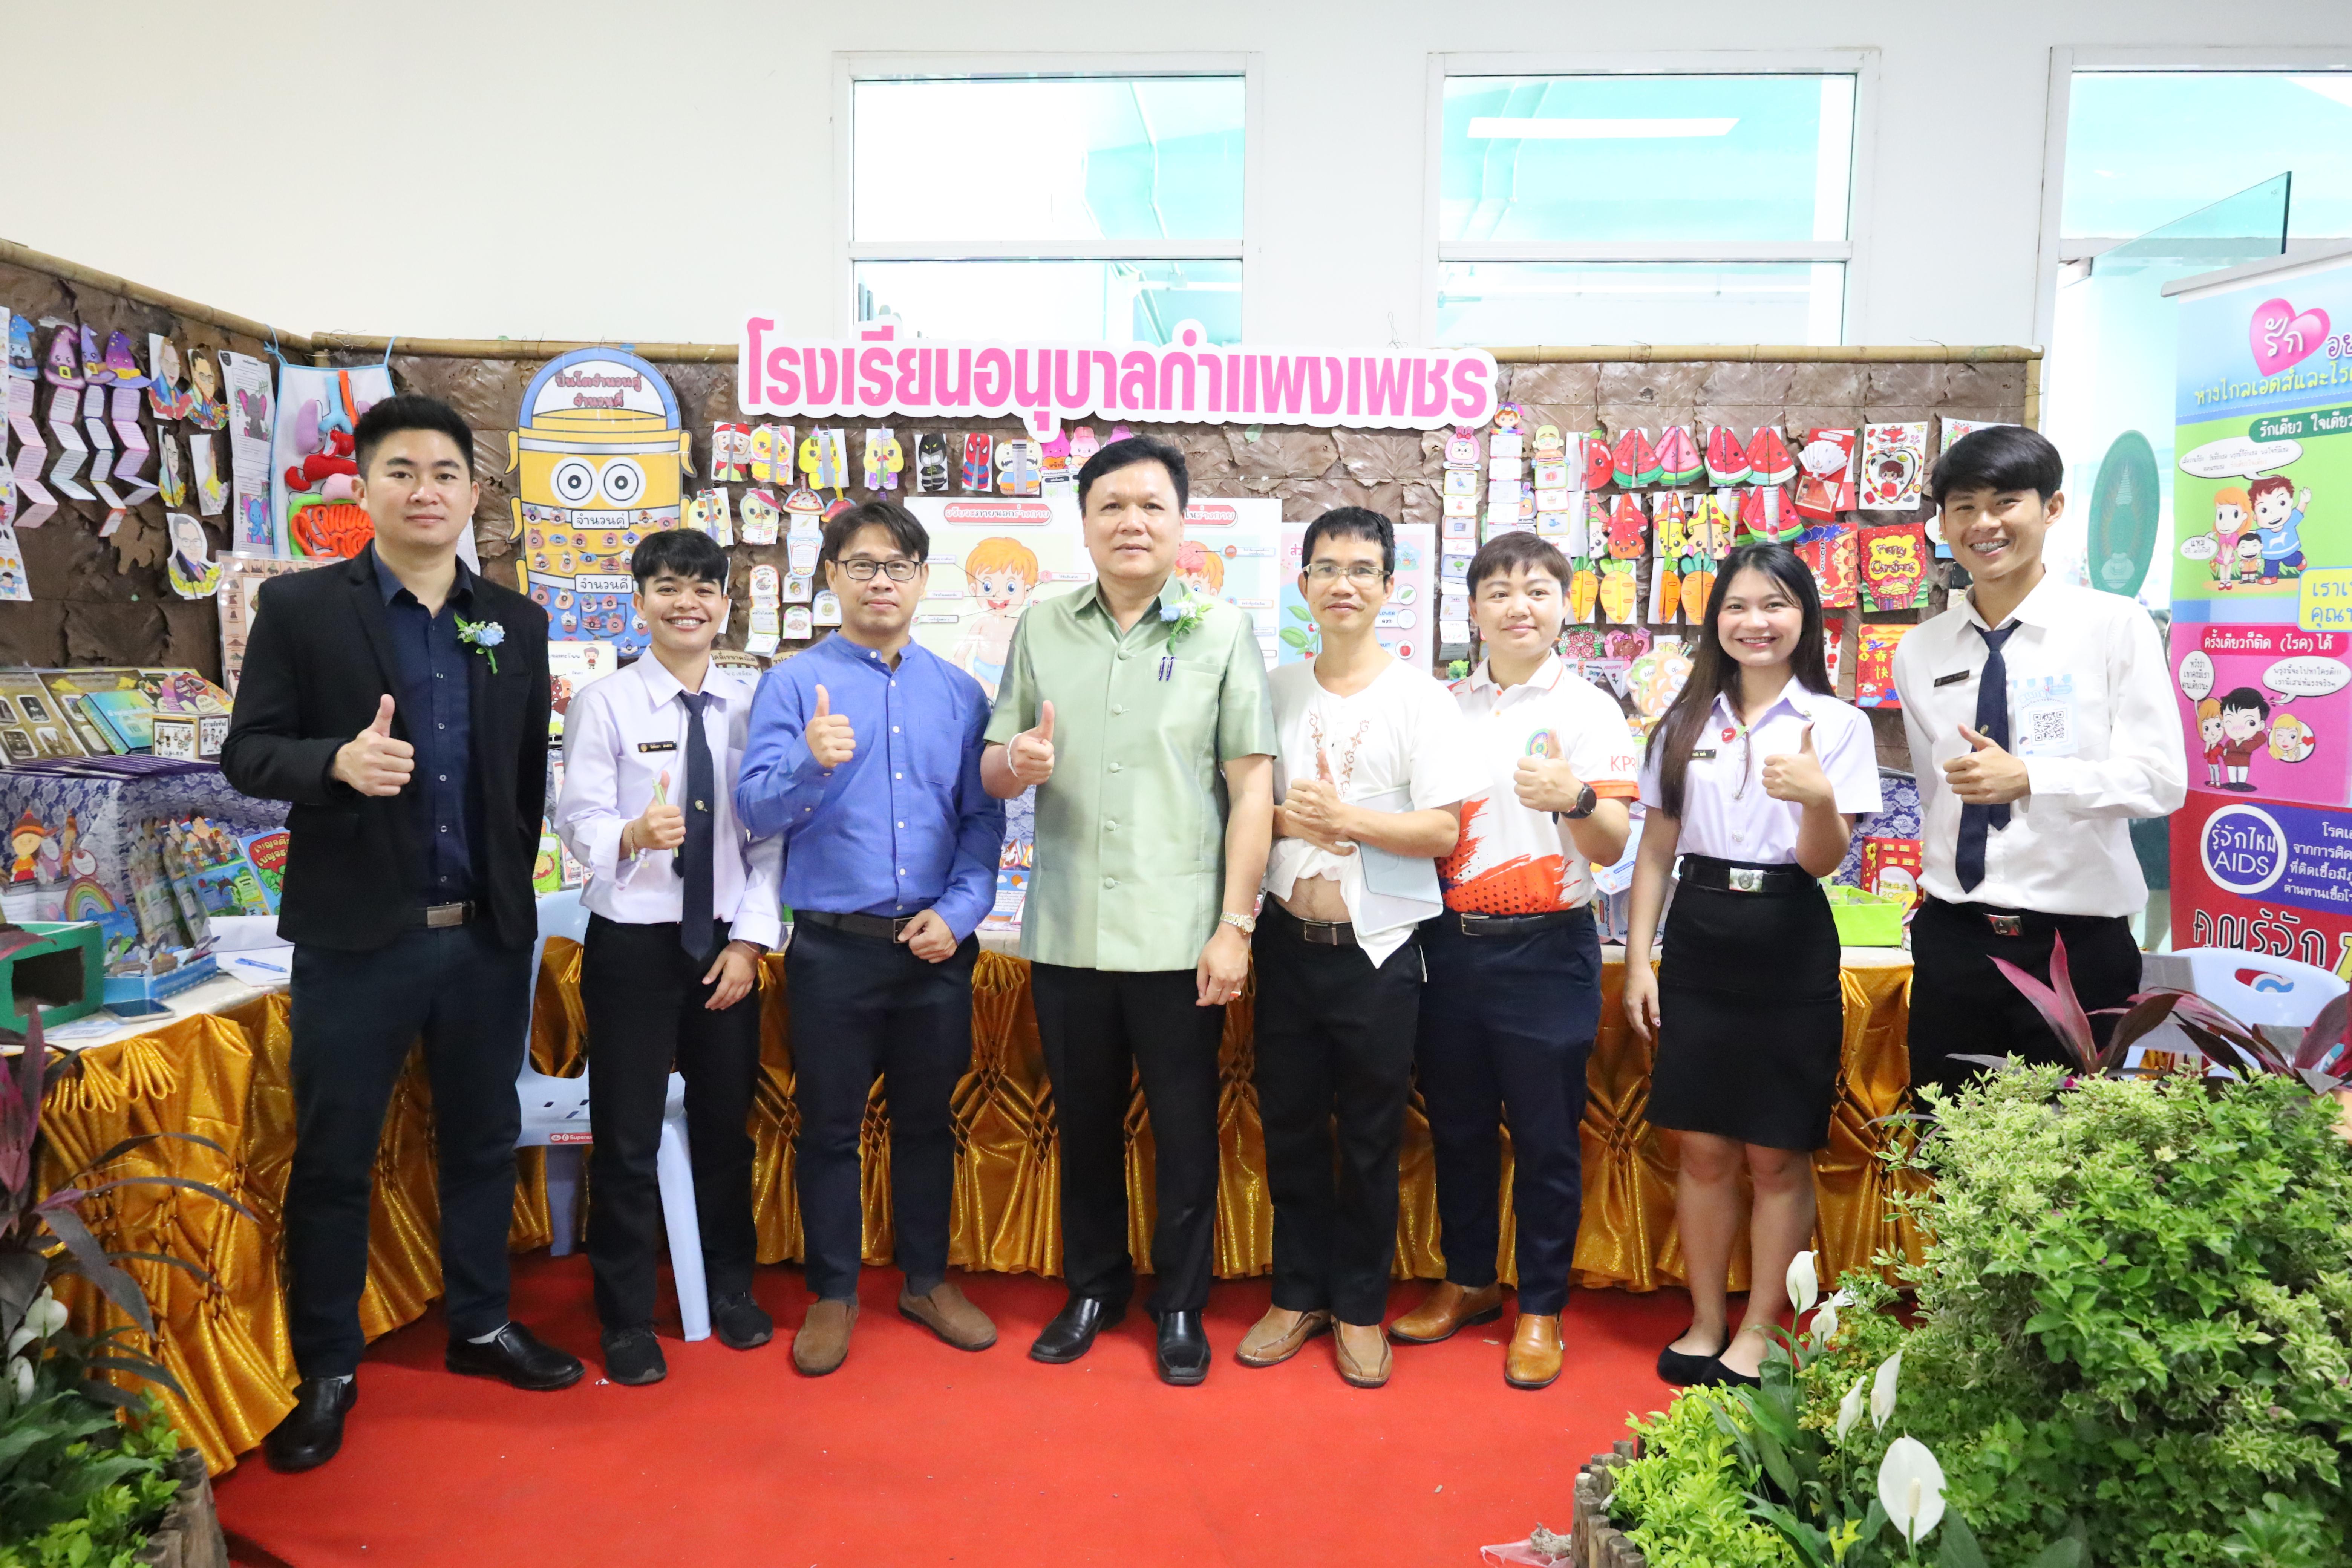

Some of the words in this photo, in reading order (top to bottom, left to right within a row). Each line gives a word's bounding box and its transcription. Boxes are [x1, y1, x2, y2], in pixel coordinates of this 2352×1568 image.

[2264, 317, 2303, 357] รัก
[747, 317, 1488, 432] โรงเรียนอนุบาลกำแพงเพชร
[2259, 418, 2302, 437] รักเดียว
[577, 513, 625, 528] จำนวนคู่
[945, 504, 1050, 519] อวัยวะภายนอกร่างกาย
[1184, 505, 1234, 519] ในร่างกาย
[2313, 582, 2352, 597] เราเ
[2205, 629, 2271, 649] ครั้งเดียวก็ติด
[2280, 634, 2314, 652] (โรค)
[2318, 634, 2334, 650] ได้
[2212, 824, 2277, 853] รู้จักไหม
[257, 849, 289, 867] เบญจธ
[2213, 851, 2269, 876] AIDS
